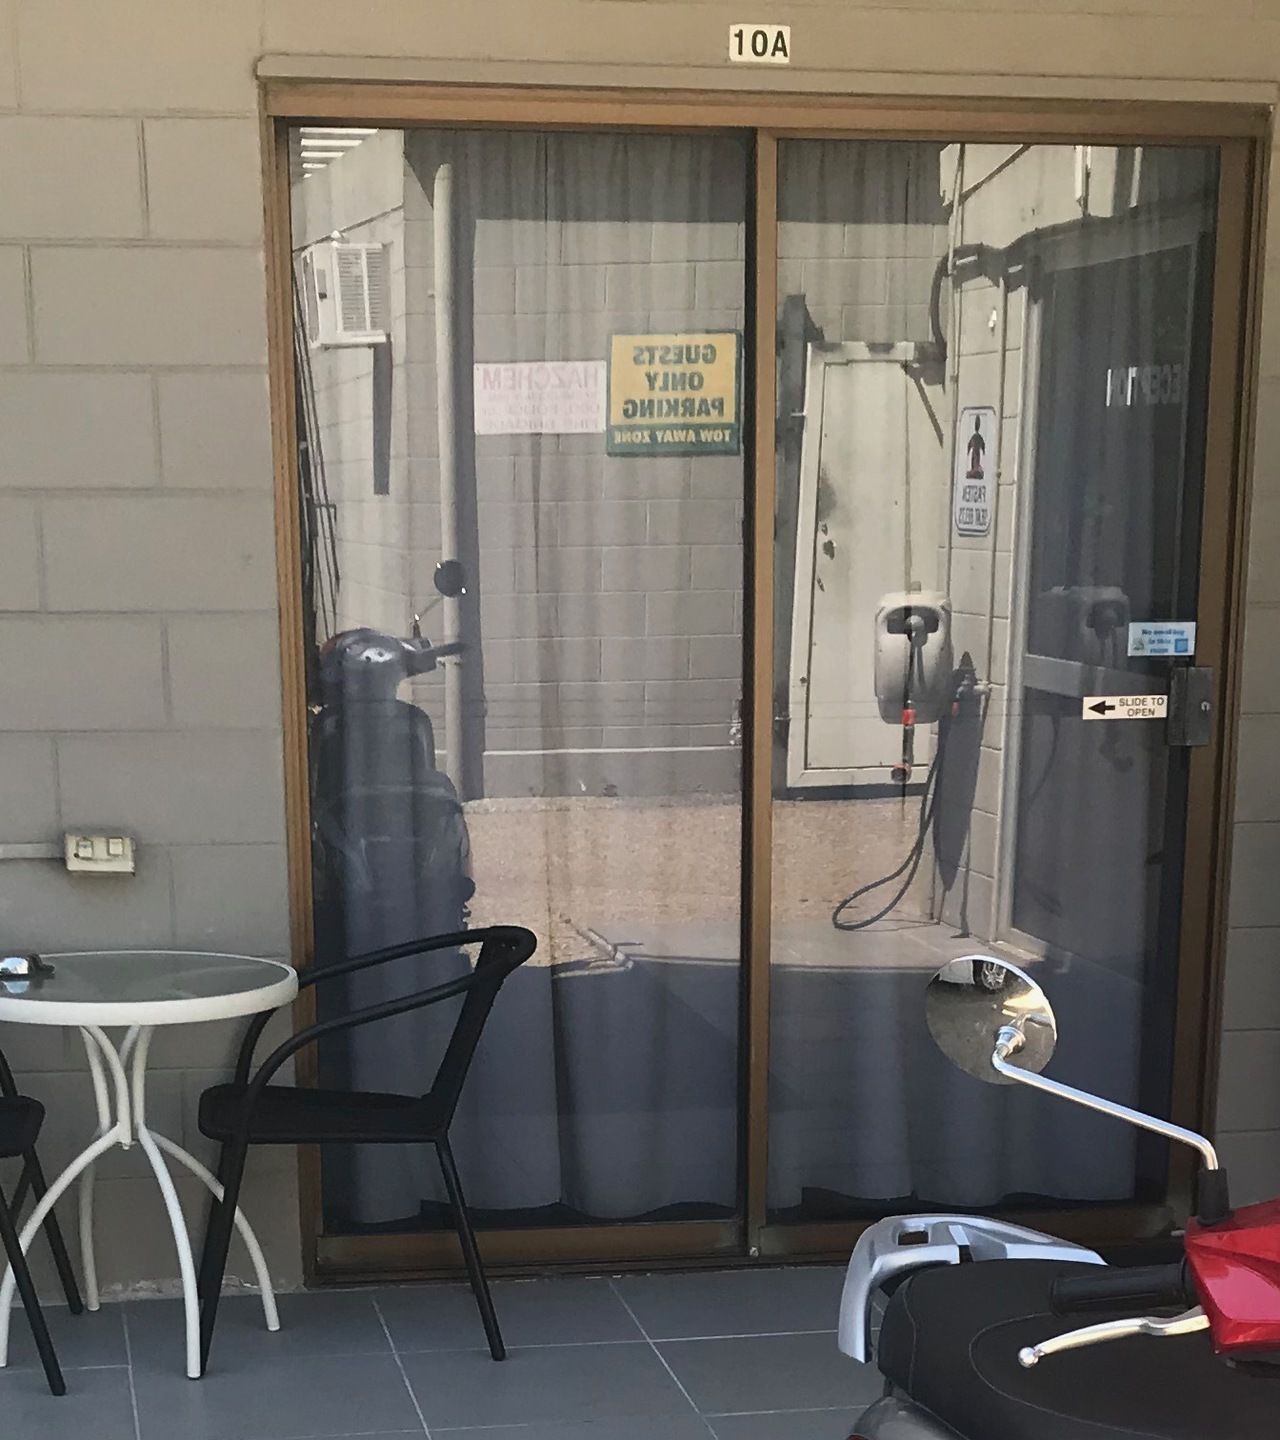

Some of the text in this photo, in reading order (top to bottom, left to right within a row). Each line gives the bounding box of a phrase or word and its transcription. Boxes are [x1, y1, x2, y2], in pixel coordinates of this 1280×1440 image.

[734, 29, 788, 57] 10A
[1119, 697, 1165, 706] SLIDE TO
[1127, 707, 1155, 717] OPEN
